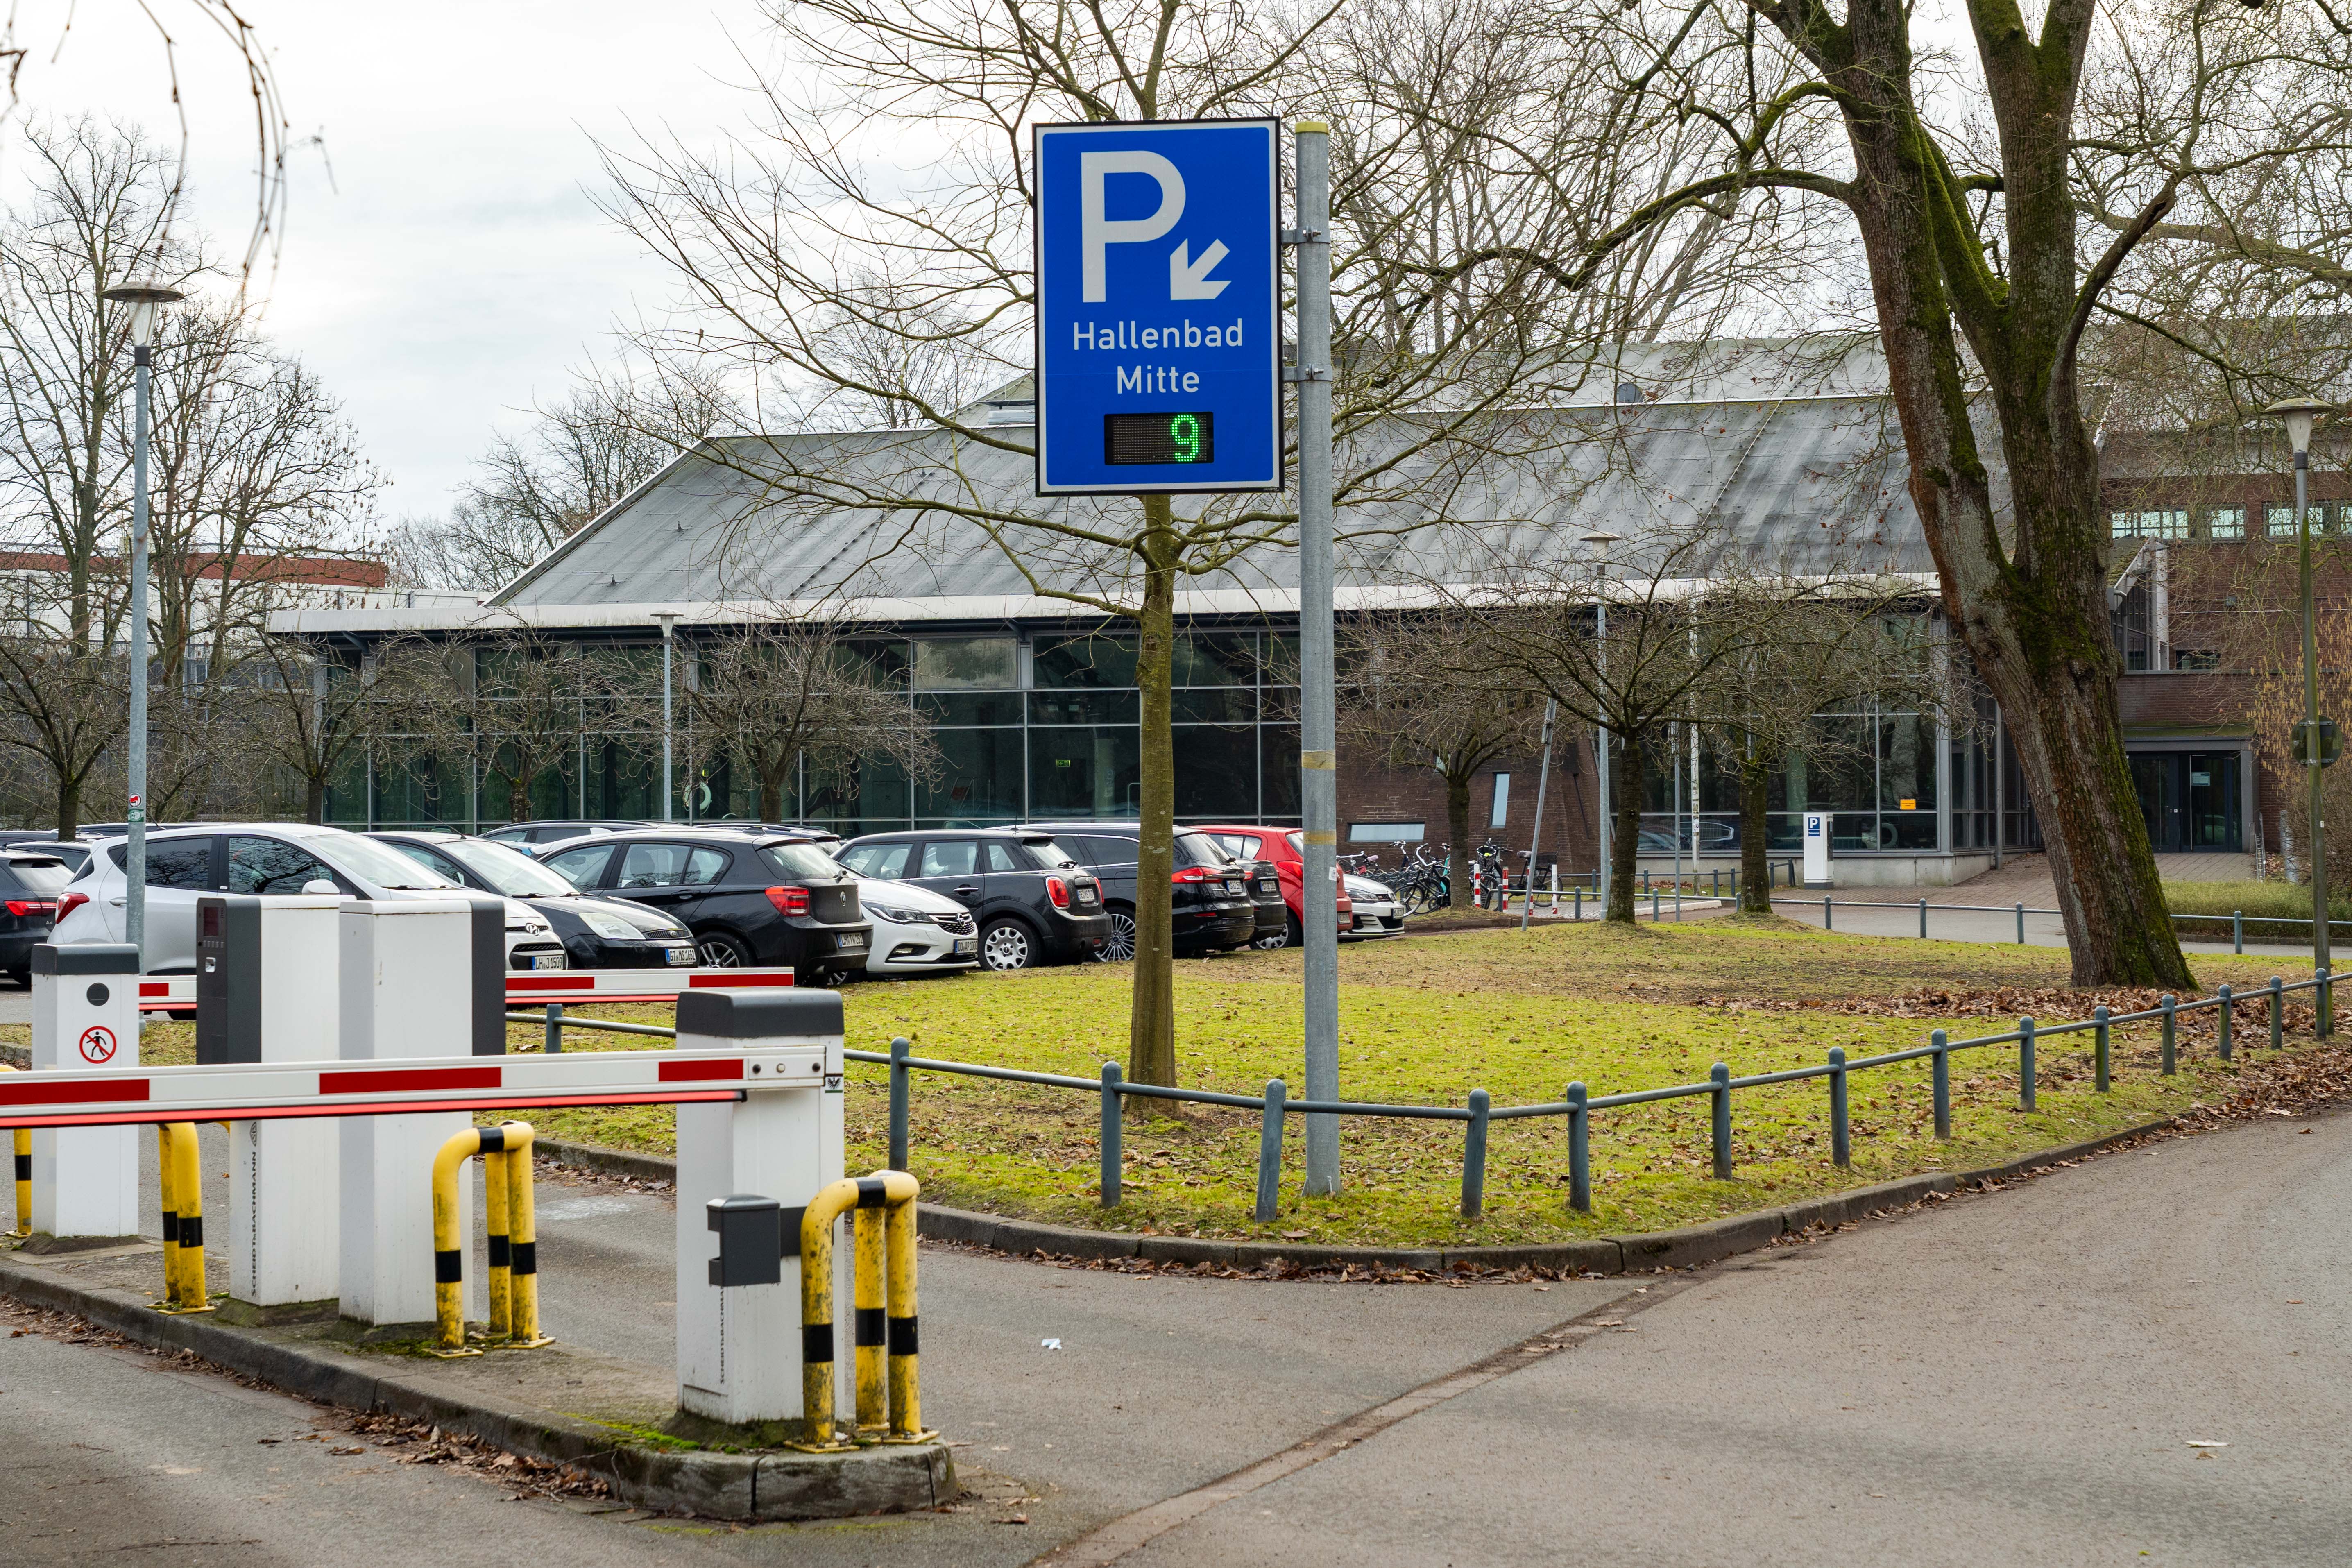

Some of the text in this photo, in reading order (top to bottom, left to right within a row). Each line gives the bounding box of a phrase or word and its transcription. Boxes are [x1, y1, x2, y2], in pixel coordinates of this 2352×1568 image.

[1081, 150, 1186, 302] P
[1074, 318, 1243, 351] Hallenbad
[1117, 365, 1200, 394] Mitte
[1171, 414, 1199, 462] 9
[1810, 818, 1818, 828] P
